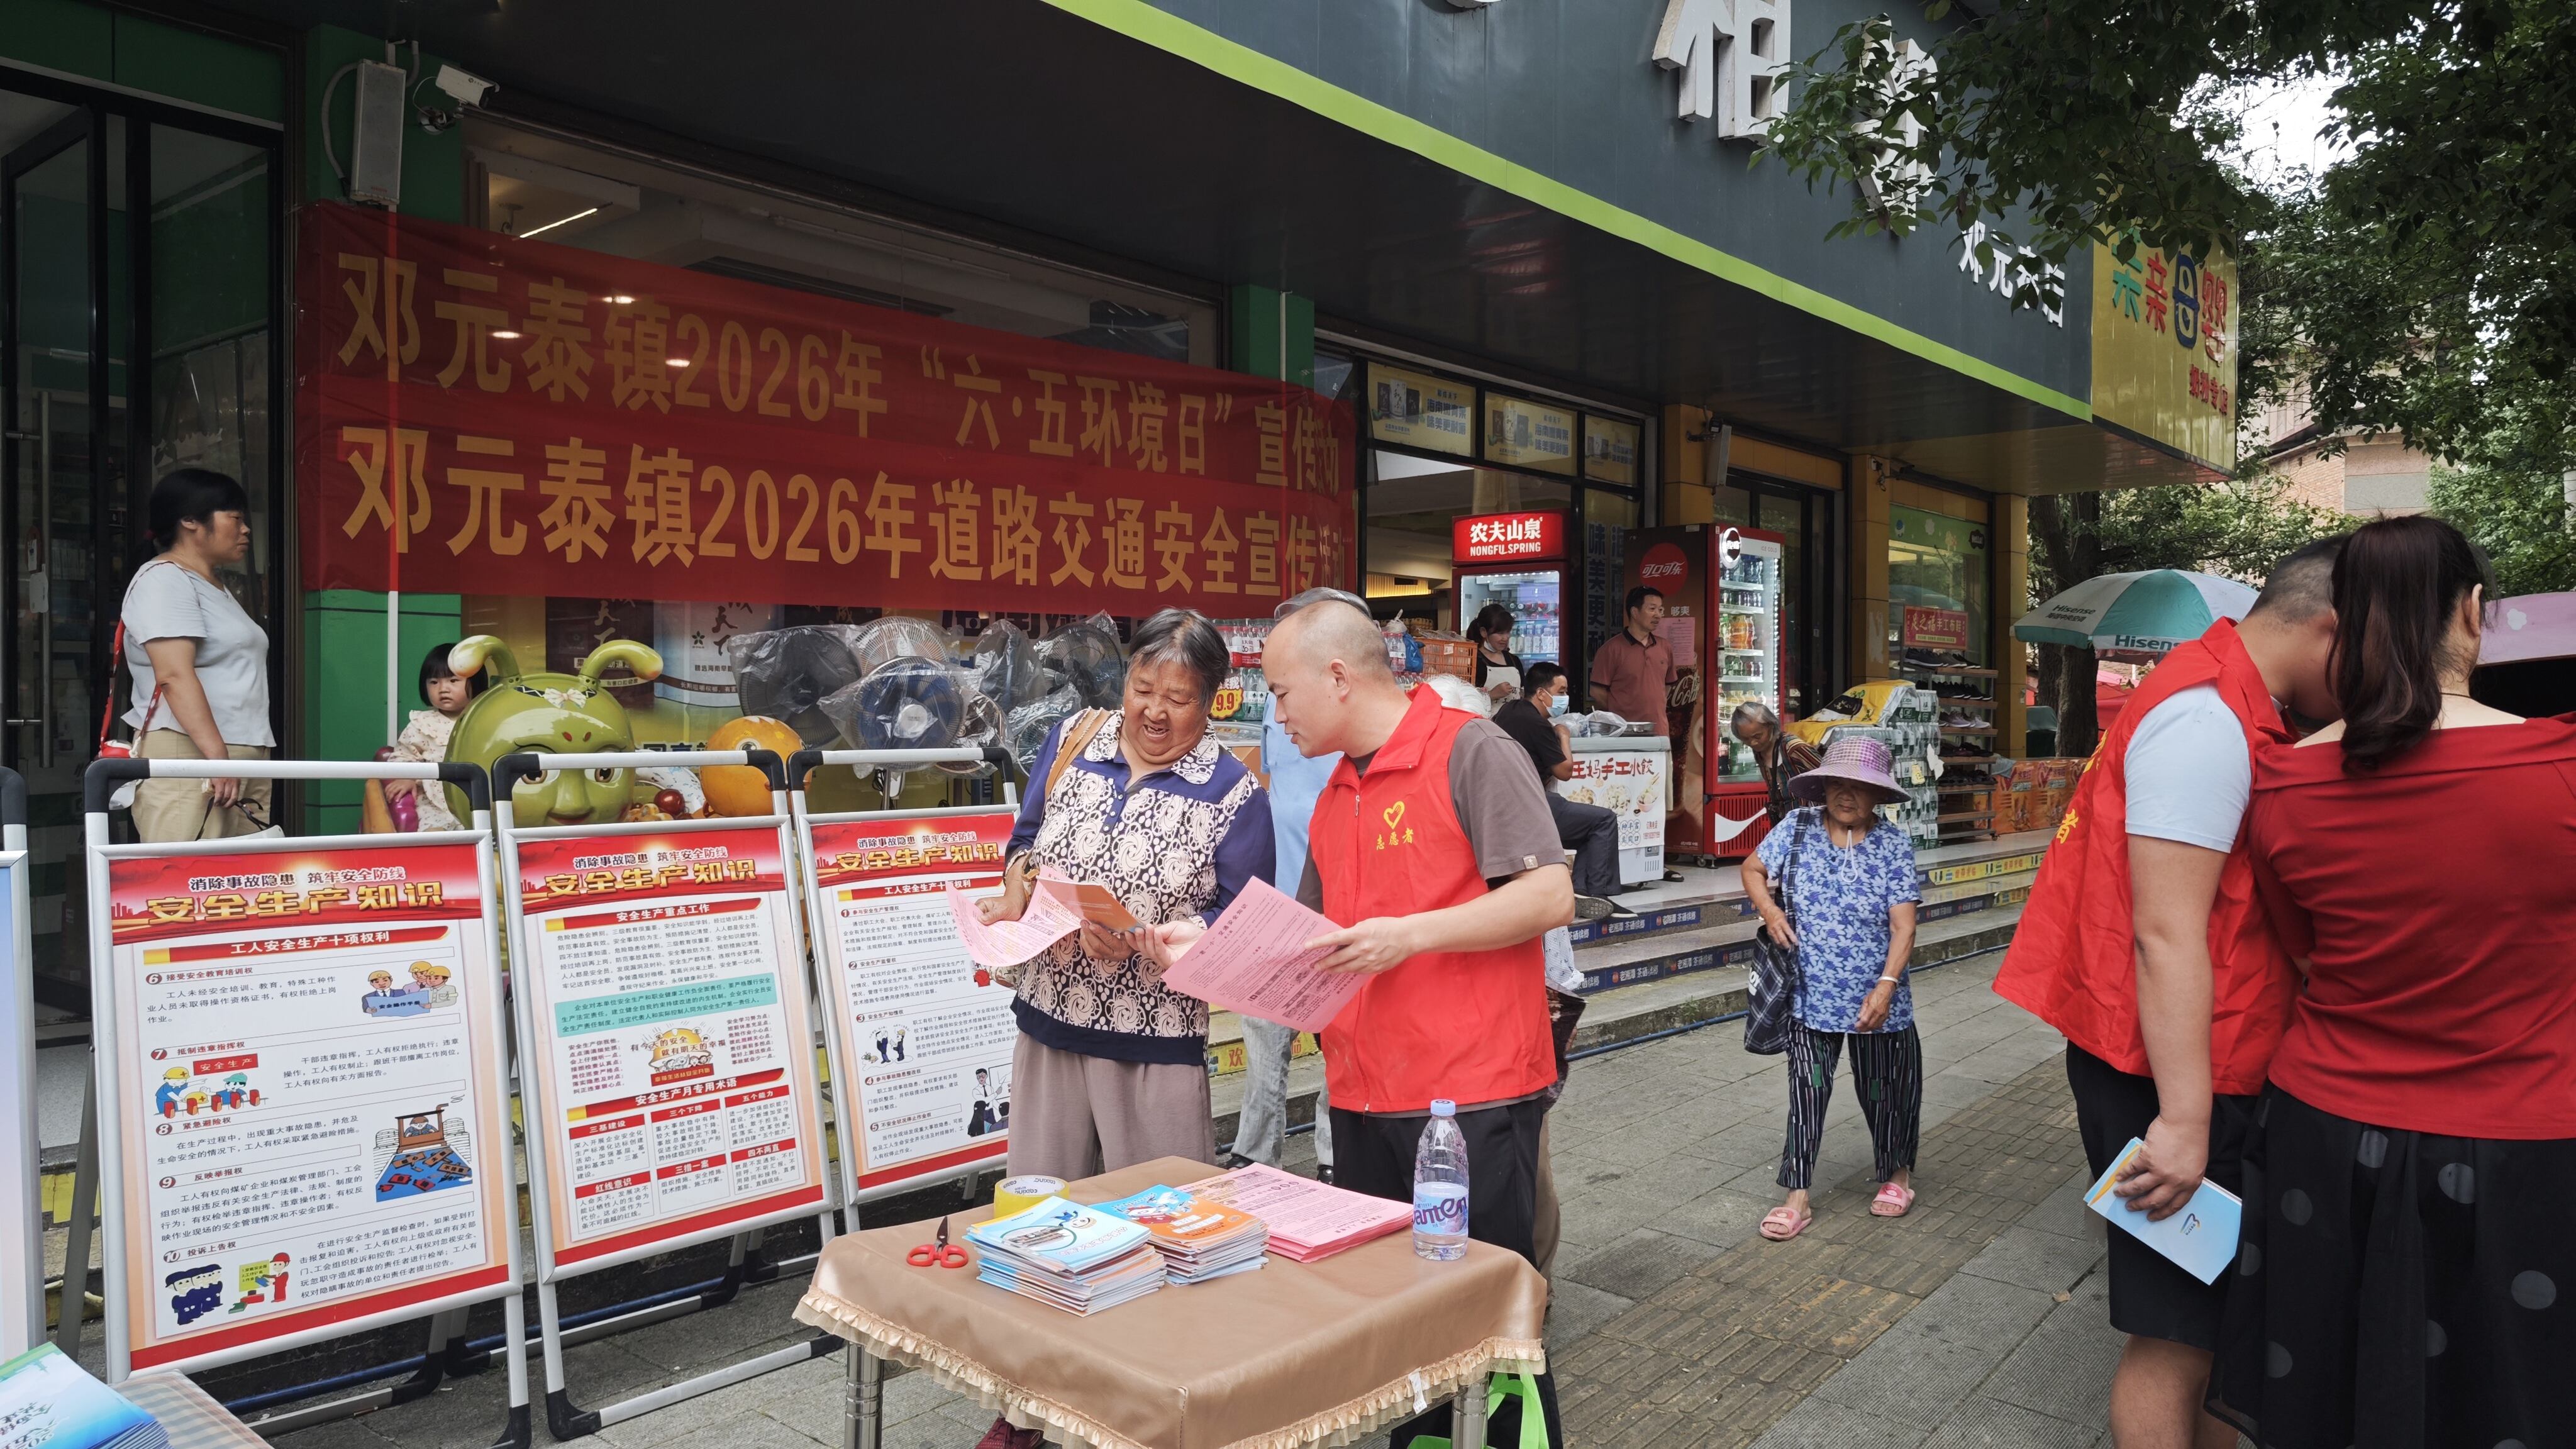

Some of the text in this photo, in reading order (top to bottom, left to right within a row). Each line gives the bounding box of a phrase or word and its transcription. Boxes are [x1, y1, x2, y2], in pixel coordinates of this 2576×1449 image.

[337, 252, 887, 438] 邓元泰镇2026年
[1470, 517, 1542, 543] 农夫山泉
[1470, 541, 1541, 557] NONGFU SPRING
[1642, 560, 1685, 579] 可口可乐
[1671, 606, 1690, 616] 够爽
[2052, 605, 2096, 615] Hisense
[2115, 635, 2180, 650] Hisens
[857, 831, 977, 849] 消除事故隐患 筑牢安全防线
[574, 847, 728, 869] 消除事故隐患 筑牢安全防线
[835, 843, 999, 873] 安全生产知识
[189, 865, 406, 892] 消除事故隐患 筑牢安全防线
[545, 859, 757, 898] 安全生产知识
[147, 880, 443, 925] 安全生产知识
[616, 904, 710, 922] 安全生产重点工作
[231, 930, 389, 955] 工人安全生产十项权利
[166, 967, 253, 981] 接受安全教育培训权
[147, 1015, 173, 1024] 作业。
[177, 1041, 245, 1056] 抵制违章指挥权
[199, 1058, 253, 1072] 安全生产
[1228, 1047, 1243, 1067] 欢
[284, 1070, 389, 1089] 工人有权向有关方面报告。
[635, 1077, 737, 1106] 安全生产月专用术语
[742, 1091, 774, 1102] 五个能力
[669, 1104, 703, 1118] 三个下降
[182, 1117, 231, 1130] 紧急避险权
[589, 1120, 626, 1133] 三基建设
[194, 1167, 243, 1181] 反映举报权
[595, 1177, 632, 1193] 红线意识
[187, 1241, 236, 1257] 投诉上告权
